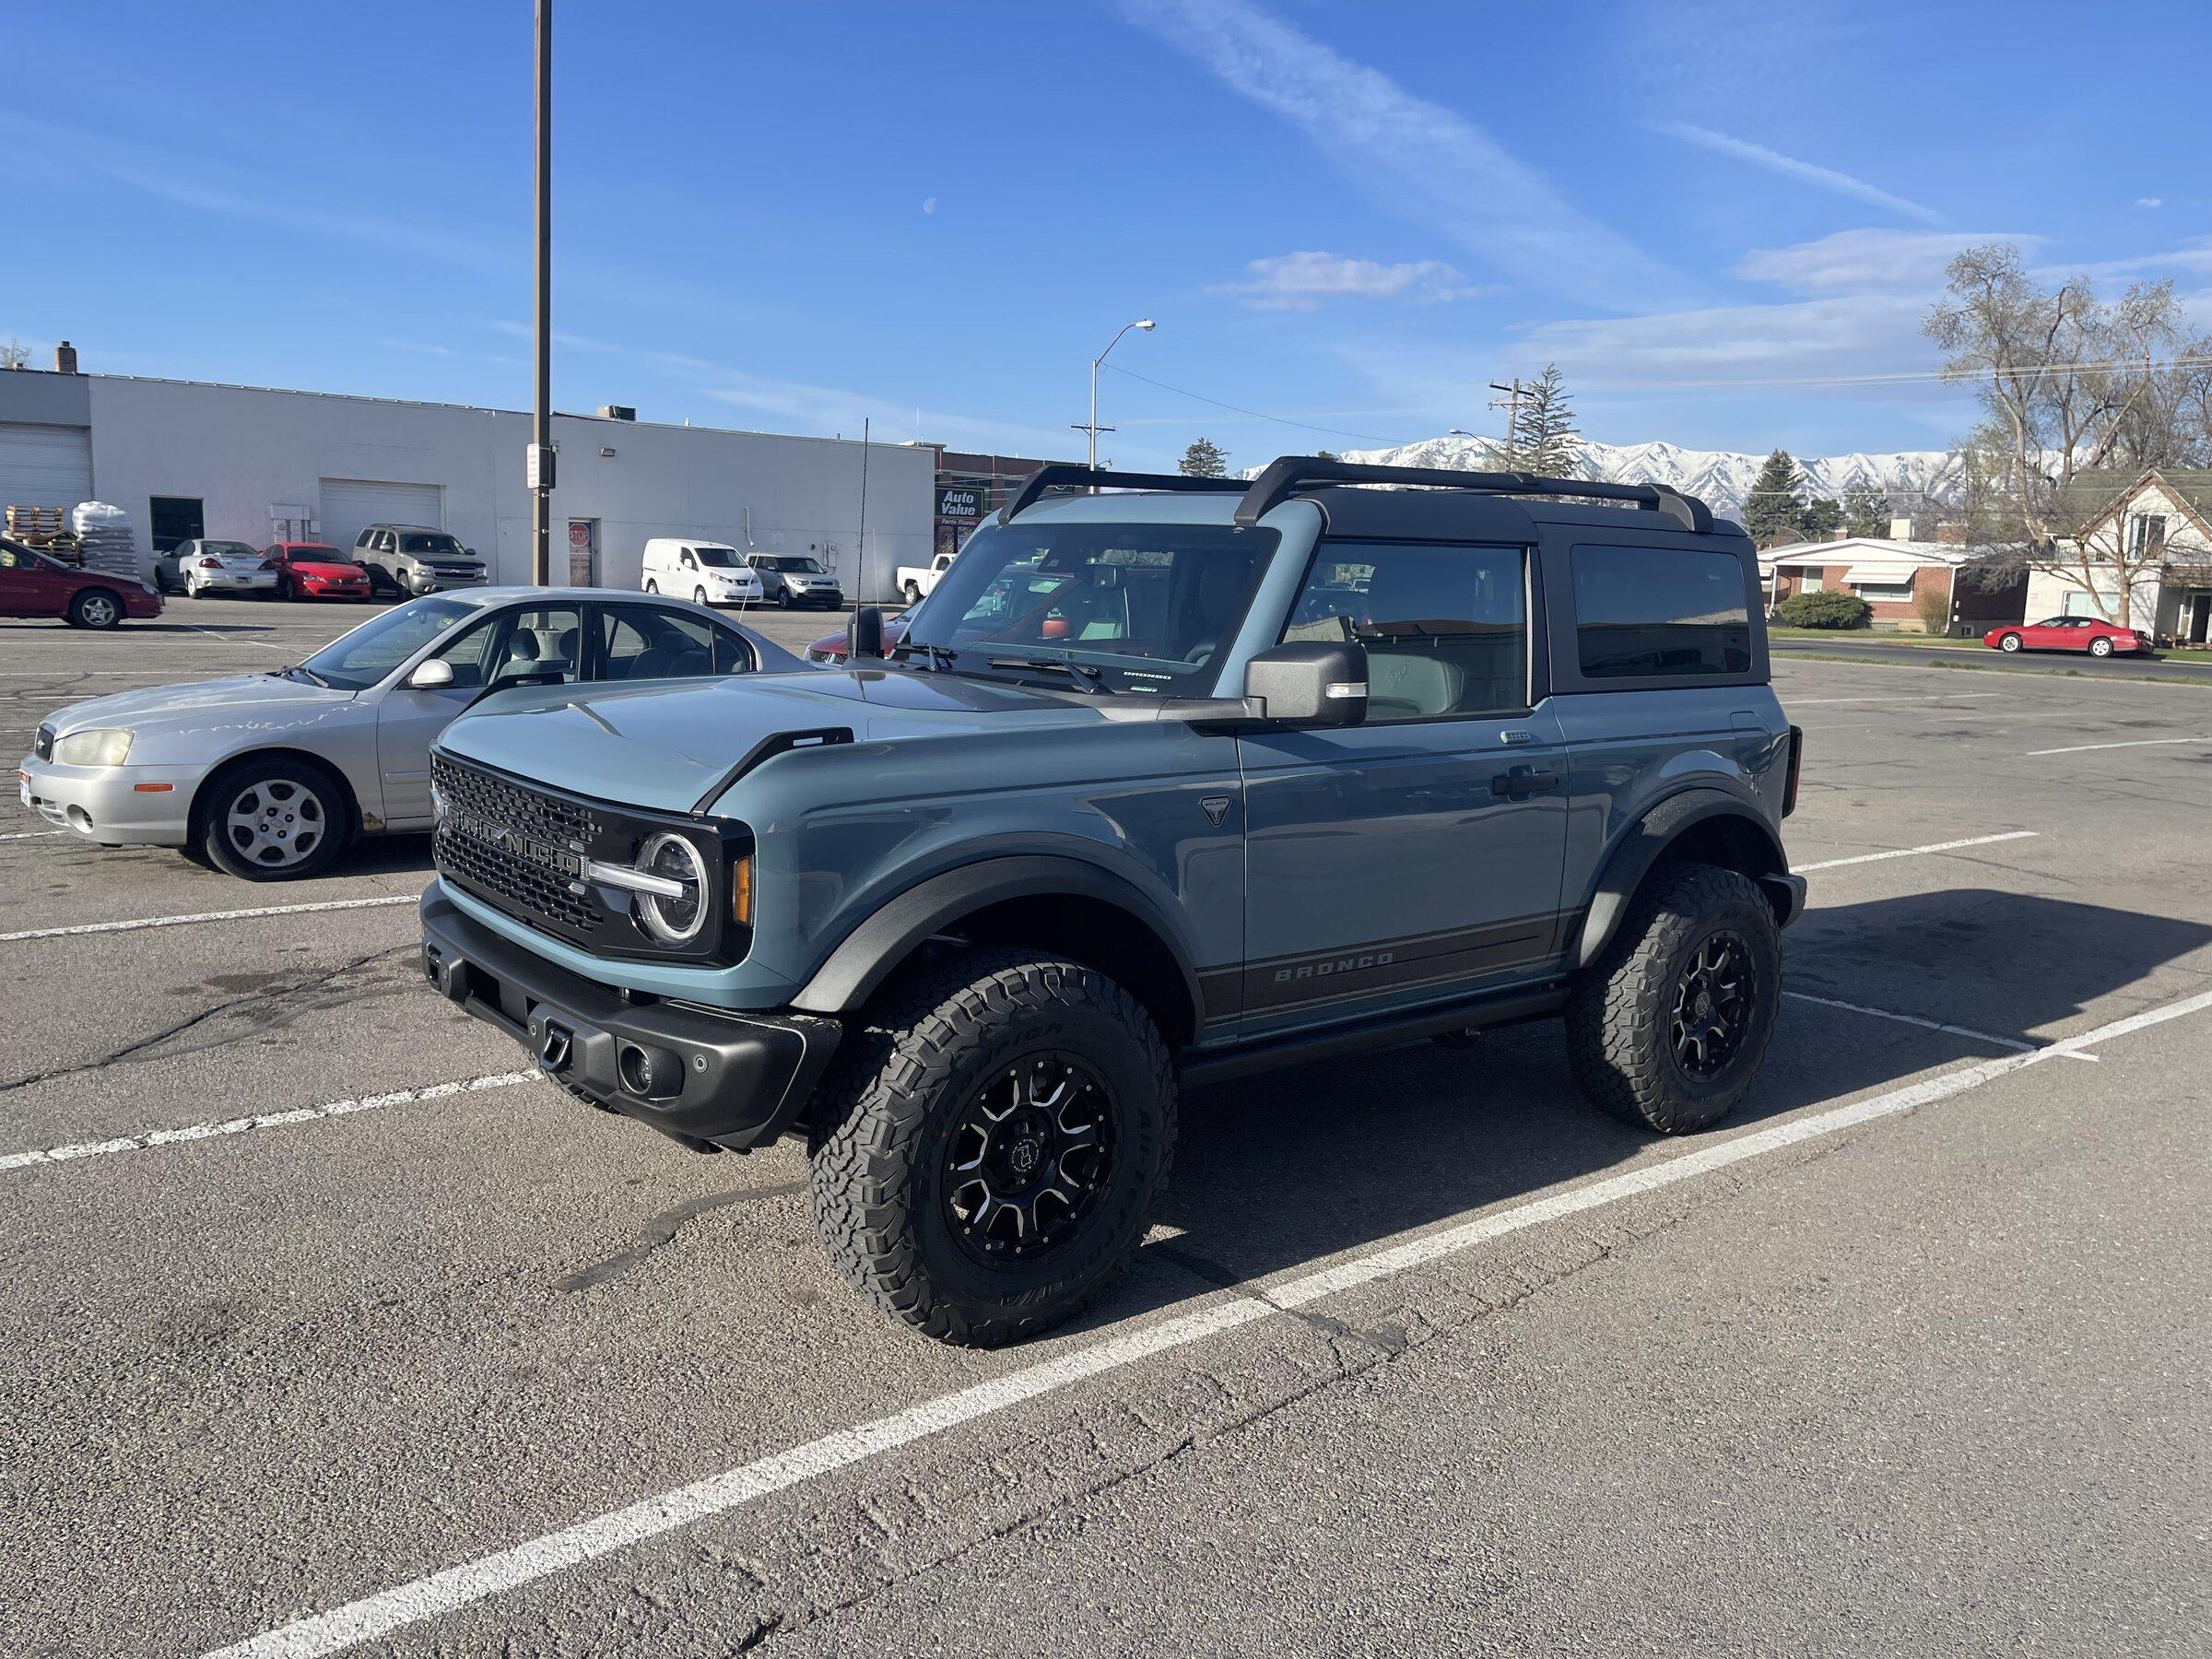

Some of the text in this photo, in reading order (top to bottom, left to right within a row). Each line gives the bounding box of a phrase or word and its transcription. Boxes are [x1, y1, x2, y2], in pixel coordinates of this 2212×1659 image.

[943, 490, 974, 504] Auto
[941, 502, 976, 516] Value
[446, 804, 580, 876] BRONCO
[1274, 954, 1394, 982] BRONCO
